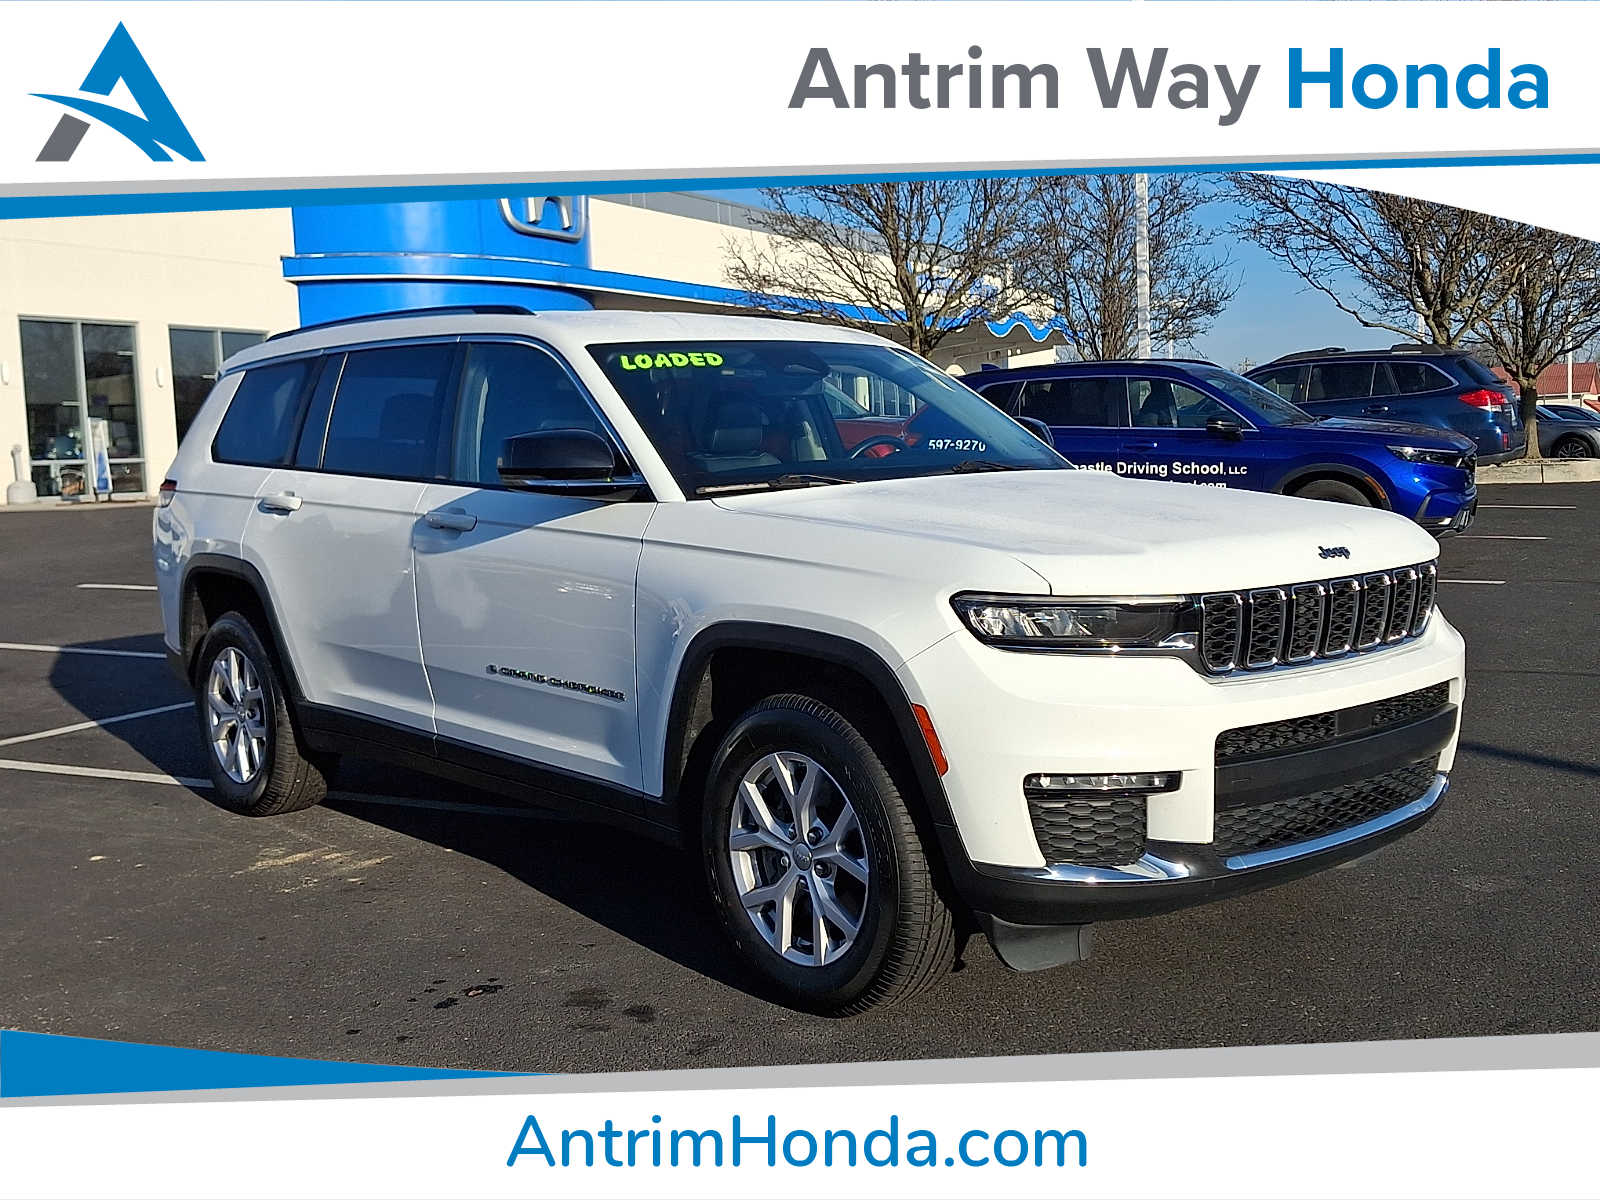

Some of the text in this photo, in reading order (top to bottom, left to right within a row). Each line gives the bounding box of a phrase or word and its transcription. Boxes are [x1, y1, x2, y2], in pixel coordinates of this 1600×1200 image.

[620, 352, 724, 370] LOADED
[928, 439, 986, 452] 597-9270
[1116, 461, 1168, 477] Driving
[1172, 461, 1226, 476] School,
[1228, 466, 1248, 475] LLC
[1318, 545, 1351, 560] Jeep
